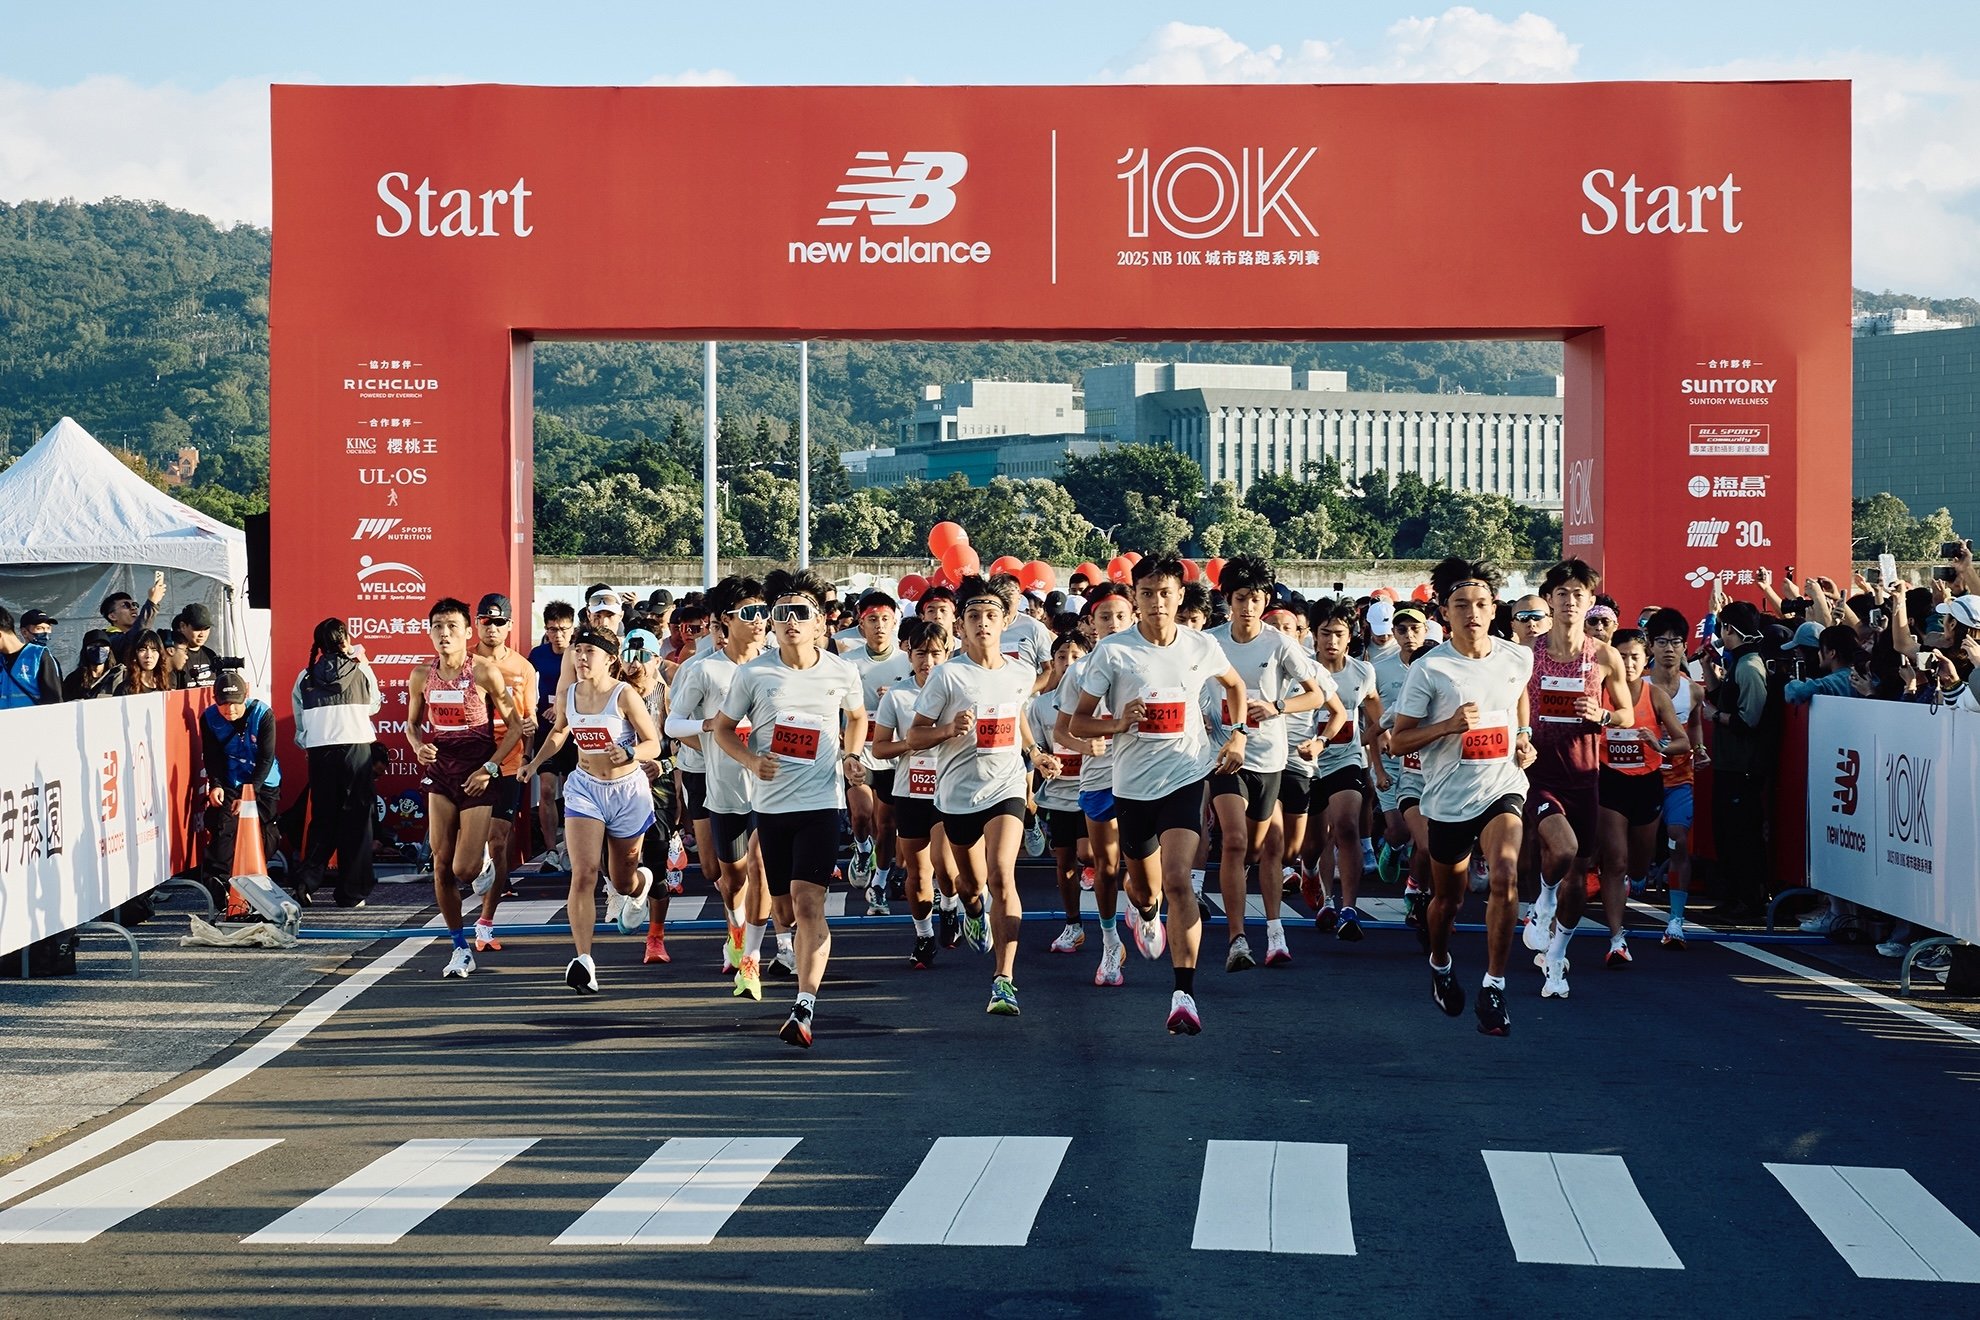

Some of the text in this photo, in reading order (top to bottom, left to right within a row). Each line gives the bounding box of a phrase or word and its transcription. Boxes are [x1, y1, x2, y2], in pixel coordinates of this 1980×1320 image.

[816, 151, 968, 226] NB
[1117, 146, 1320, 239] 10K
[376, 171, 534, 237] Start
[1581, 168, 1743, 235] Start
[788, 236, 991, 264] new balance
[1117, 250, 1320, 266] 2025 NB 10K 城市路跑系列賽
[369, 360, 412, 369] 協力夥伴
[1708, 359, 1752, 368] 合作夥伴
[343, 379, 439, 390] RICHCLUB
[1681, 379, 1777, 393] SUNTORY
[369, 418, 412, 428] 合作夥伴
[1720, 429, 1761, 437] SPORTS
[346, 438, 376, 449] KING
[387, 438, 438, 454] 櫻桃王
[1713, 476, 1766, 489] 海昌
[1687, 517, 1730, 534] amino
[1686, 533, 1718, 547] VITAL
[1735, 520, 1771, 547] 30th
[360, 582, 426, 593] WELLCON
[369, 654, 435, 664] BOSE
[575, 732, 606, 741] 06376
[980, 724, 1012, 735] 05209
[775, 730, 814, 746] 05212
[1465, 733, 1503, 747] 05210
[1609, 744, 1639, 754] 00082
[912, 774, 937, 784] 0523
[1832, 748, 1860, 816] NB
[1886, 753, 1932, 847] 10K
[1826, 824, 1866, 853] new balance
